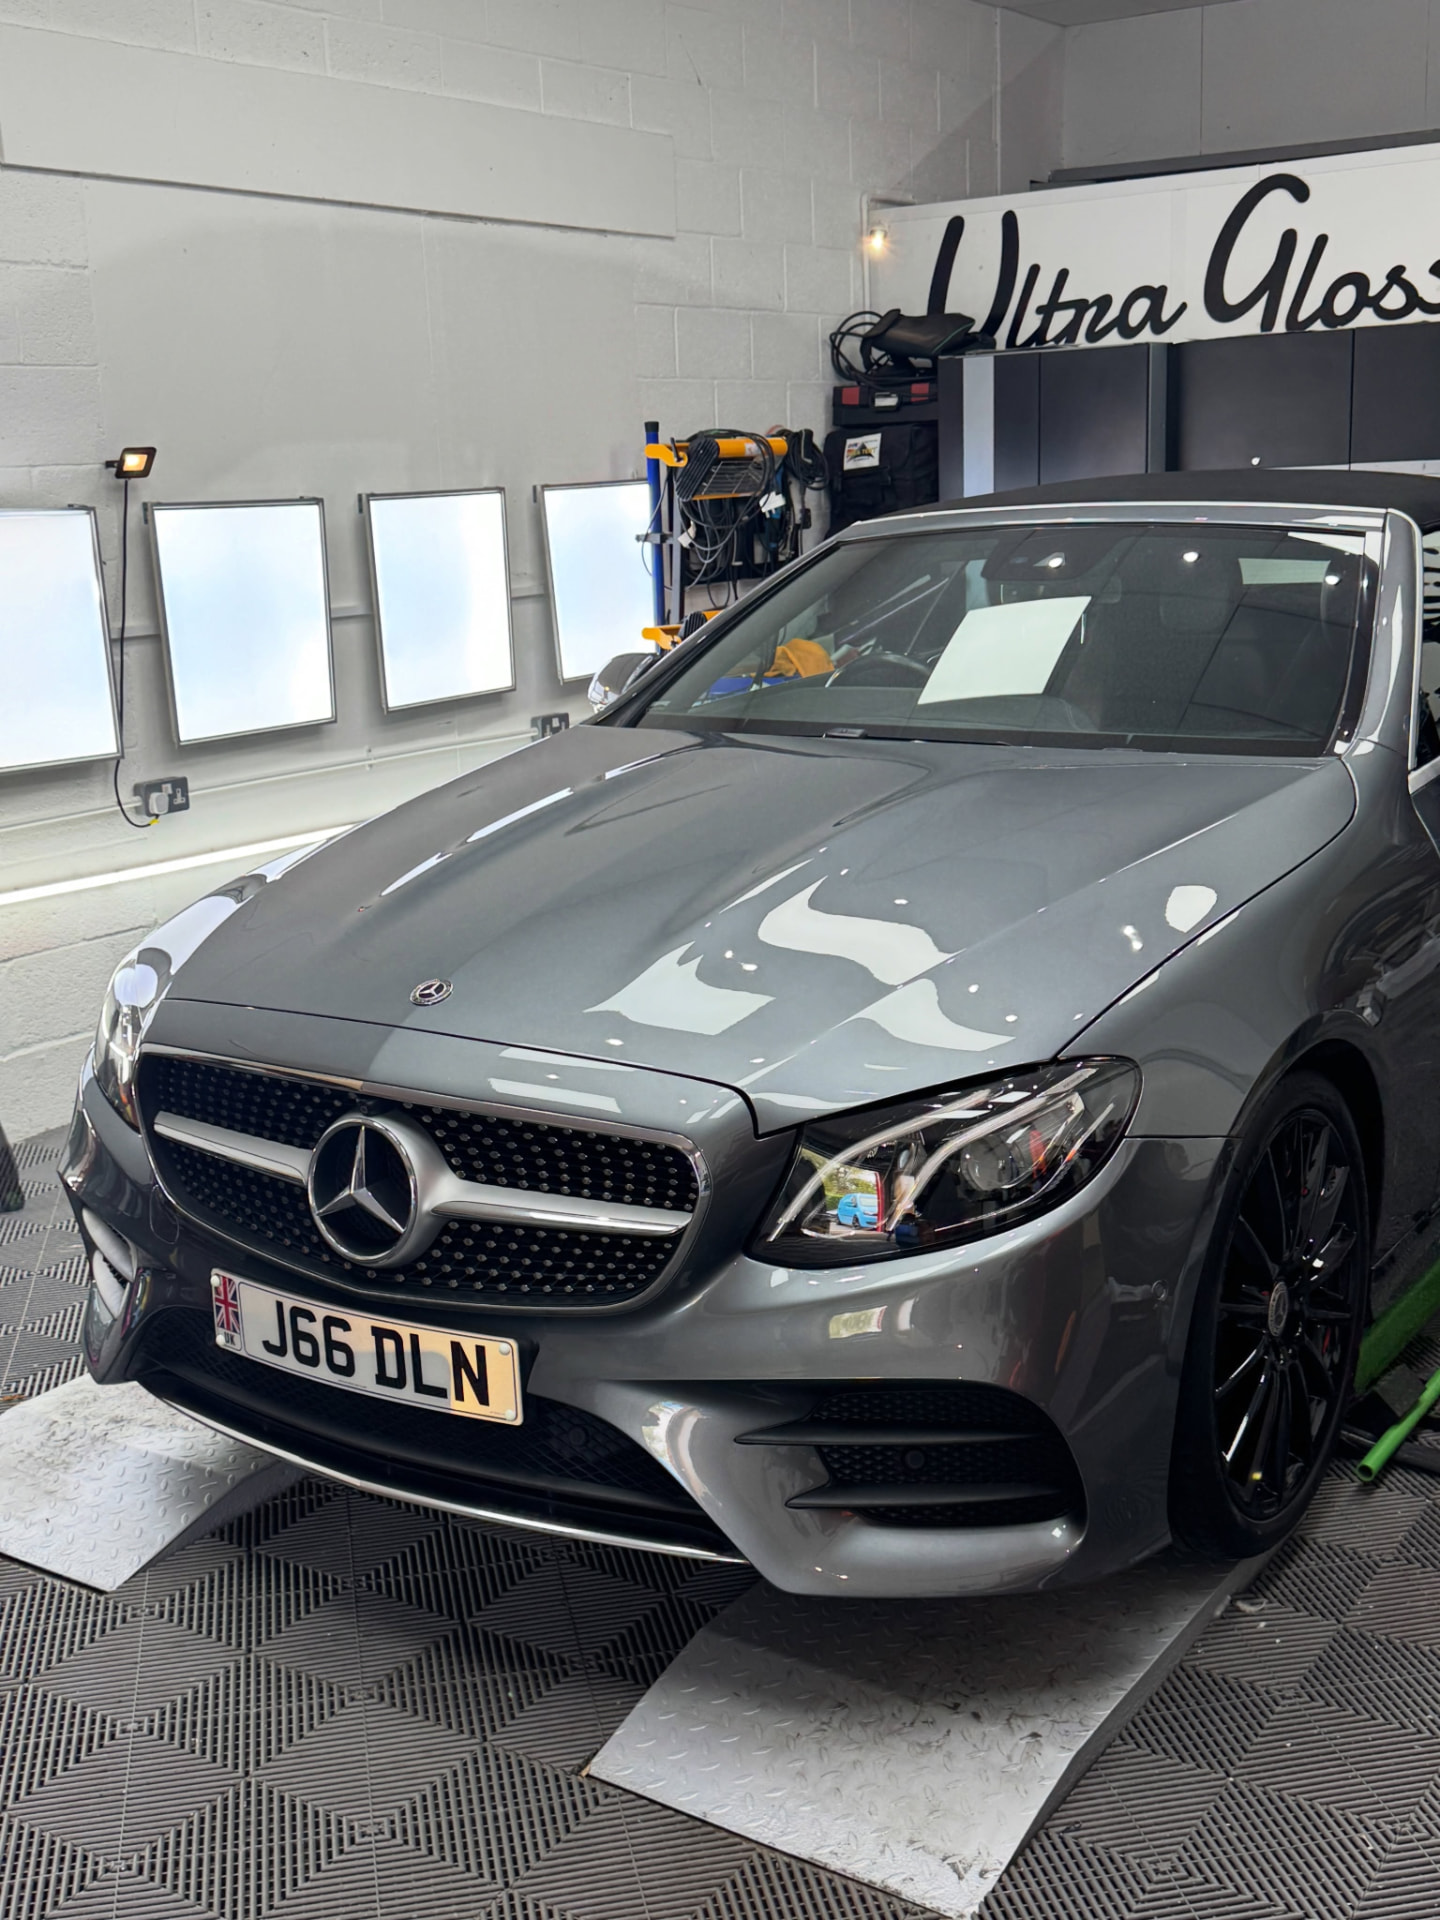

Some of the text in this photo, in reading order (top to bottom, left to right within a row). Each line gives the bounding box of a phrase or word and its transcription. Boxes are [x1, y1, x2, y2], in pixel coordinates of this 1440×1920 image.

[927, 210, 1186, 348] Ultra
[223, 1331, 236, 1346] UK
[262, 1300, 490, 1407] J66 DLN
